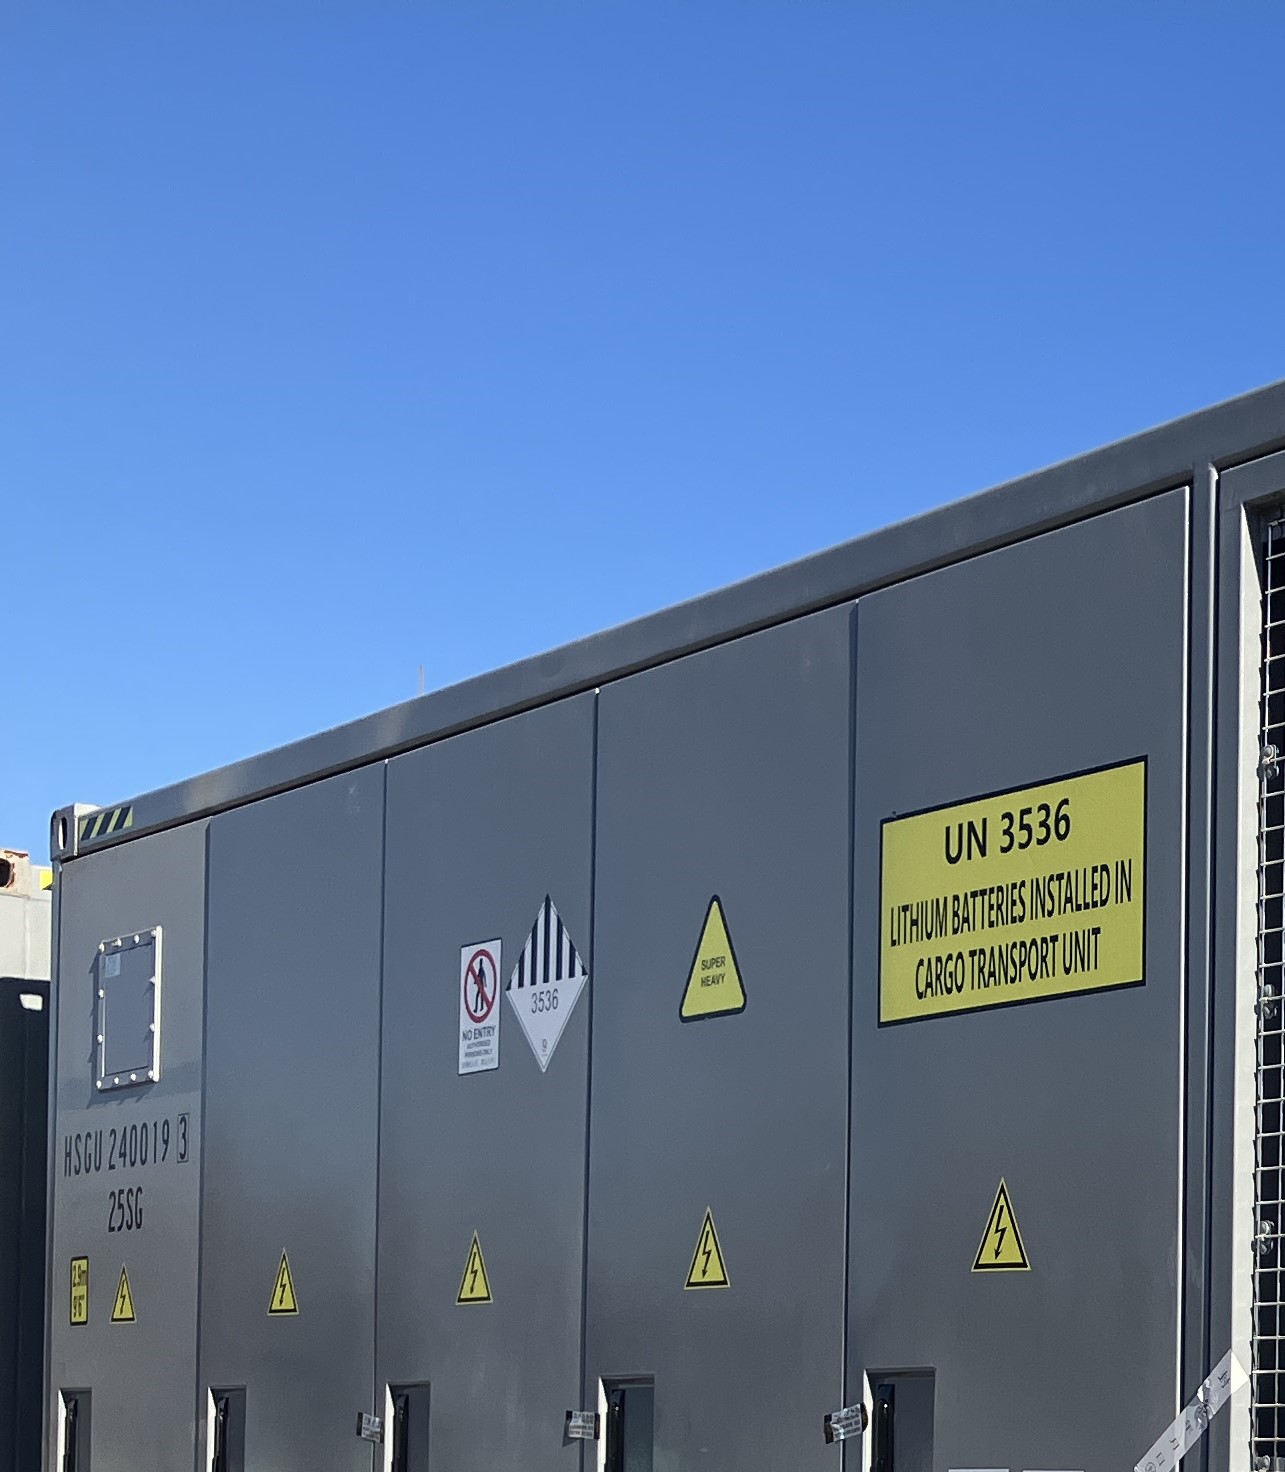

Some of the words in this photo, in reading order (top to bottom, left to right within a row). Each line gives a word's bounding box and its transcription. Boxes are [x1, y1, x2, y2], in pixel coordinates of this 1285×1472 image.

[945, 817, 988, 864] UN
[1000, 798, 1071, 854] 3536
[890, 895, 948, 947] LITHIUM
[952, 880, 1026, 936] BATTERIES
[1030, 863, 1111, 921] INSTALLED
[1115, 858, 1132, 905] IN
[701, 955, 726, 971] SUPER
[701, 973, 726, 988] HEAVY
[915, 951, 965, 1000] CARGO
[968, 934, 1059, 990] TRANSPORT
[1062, 926, 1101, 976] UNIT
[531, 988, 559, 1014] 3536
[462, 1028, 473, 1042] NO
[474, 1024, 497, 1040] ENTRY
[64, 1129, 103, 1177] HSGU
[108, 1118, 170, 1171] 240019
[179, 1116, 188, 1160] 3
[108, 1186, 143, 1233] 25SG
